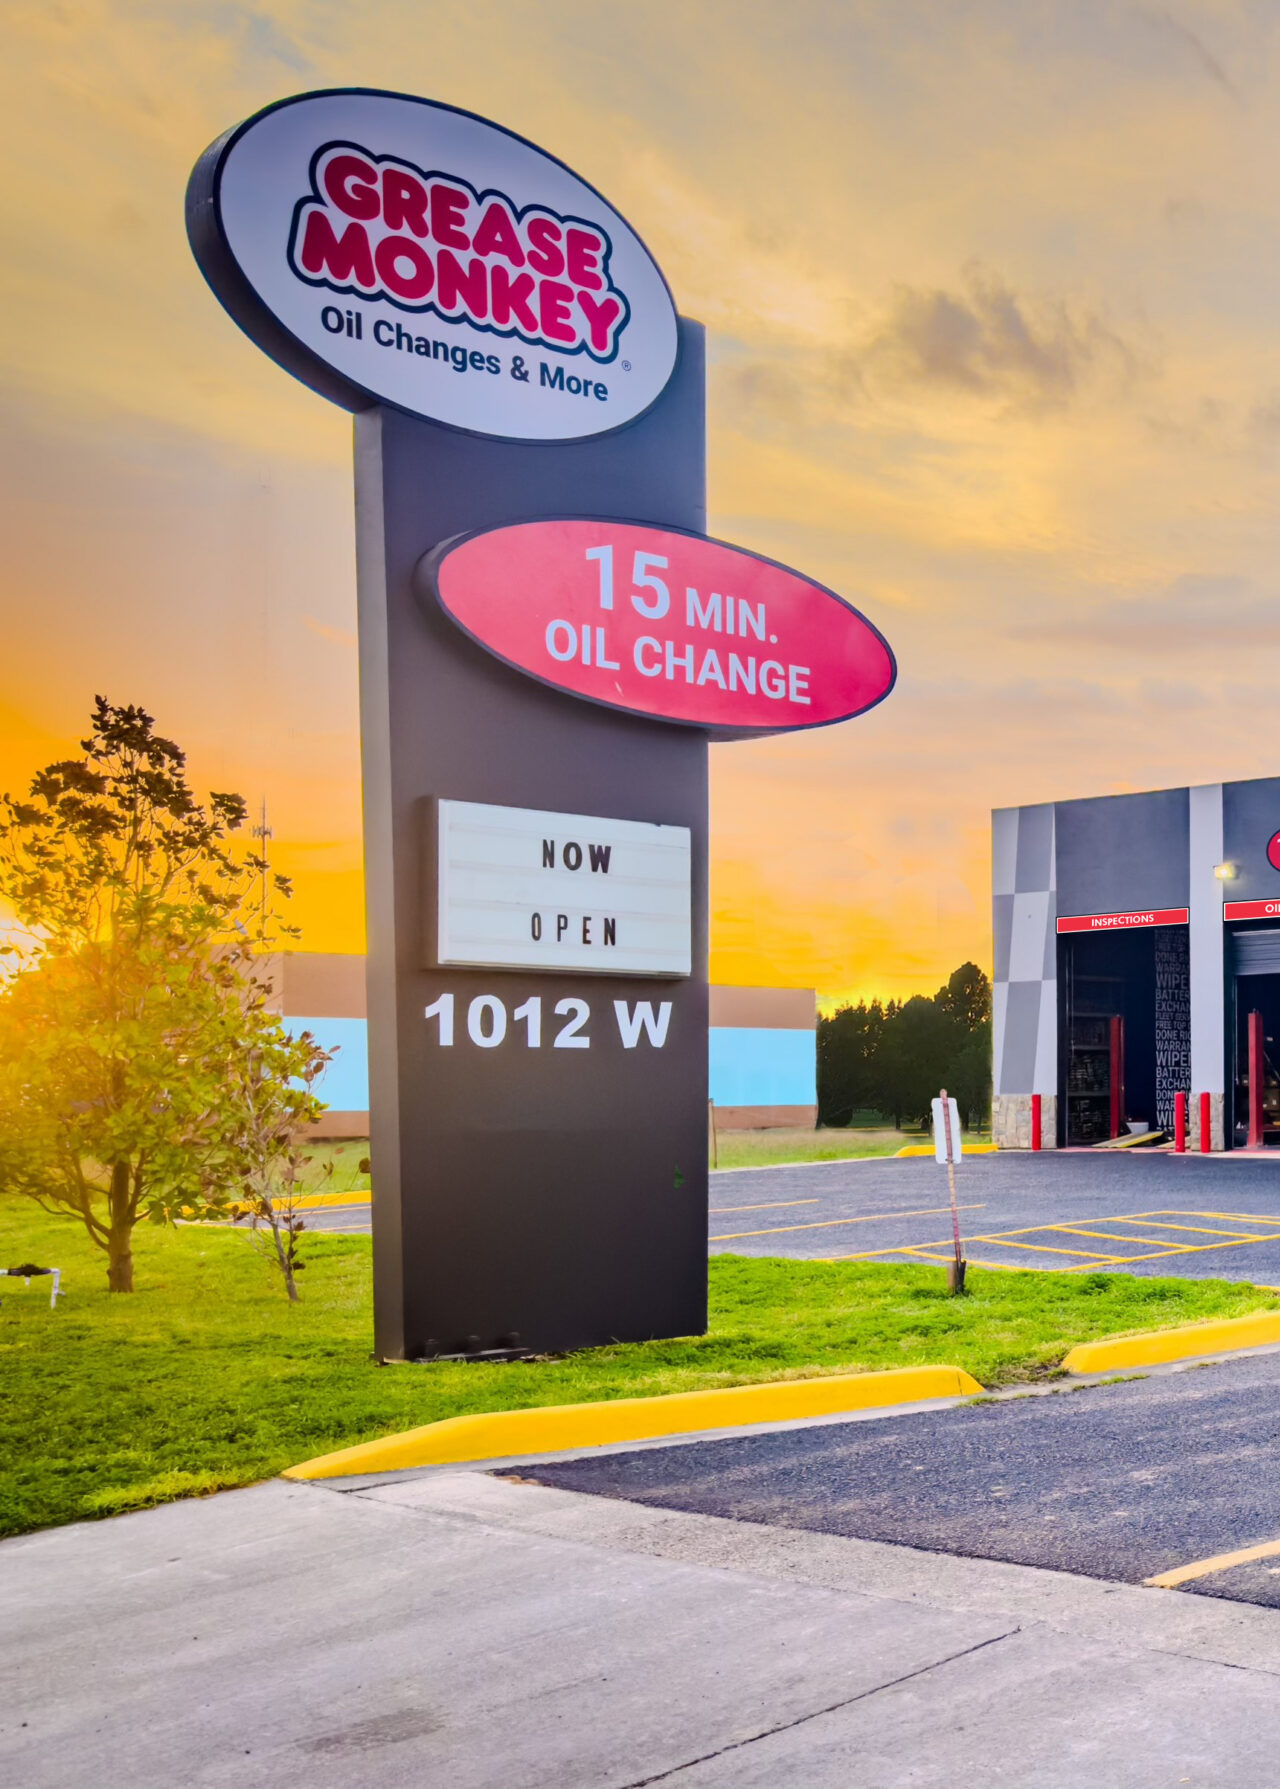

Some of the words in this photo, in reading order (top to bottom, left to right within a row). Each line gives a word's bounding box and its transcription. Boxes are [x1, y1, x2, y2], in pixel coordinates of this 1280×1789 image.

[323, 155, 602, 291] GREASE
[300, 210, 620, 352] MONKEY
[321, 305, 362, 341] Oil
[372, 320, 500, 375] Changes
[510, 355, 530, 383] &
[539, 366, 609, 402] More
[585, 543, 671, 620] 15
[686, 586, 778, 643] MIN.
[545, 618, 620, 671] OIL
[633, 635, 811, 704] CHANGE
[542, 839, 612, 874] NOW
[531, 912, 616, 946] OPEN
[1091, 913, 1155, 928] INSPECTIONS
[425, 993, 591, 1049] 1012
[613, 999, 673, 1049] W
[1156, 1029, 1178, 1040] DONE
[1156, 1089, 1176, 1100] DON
